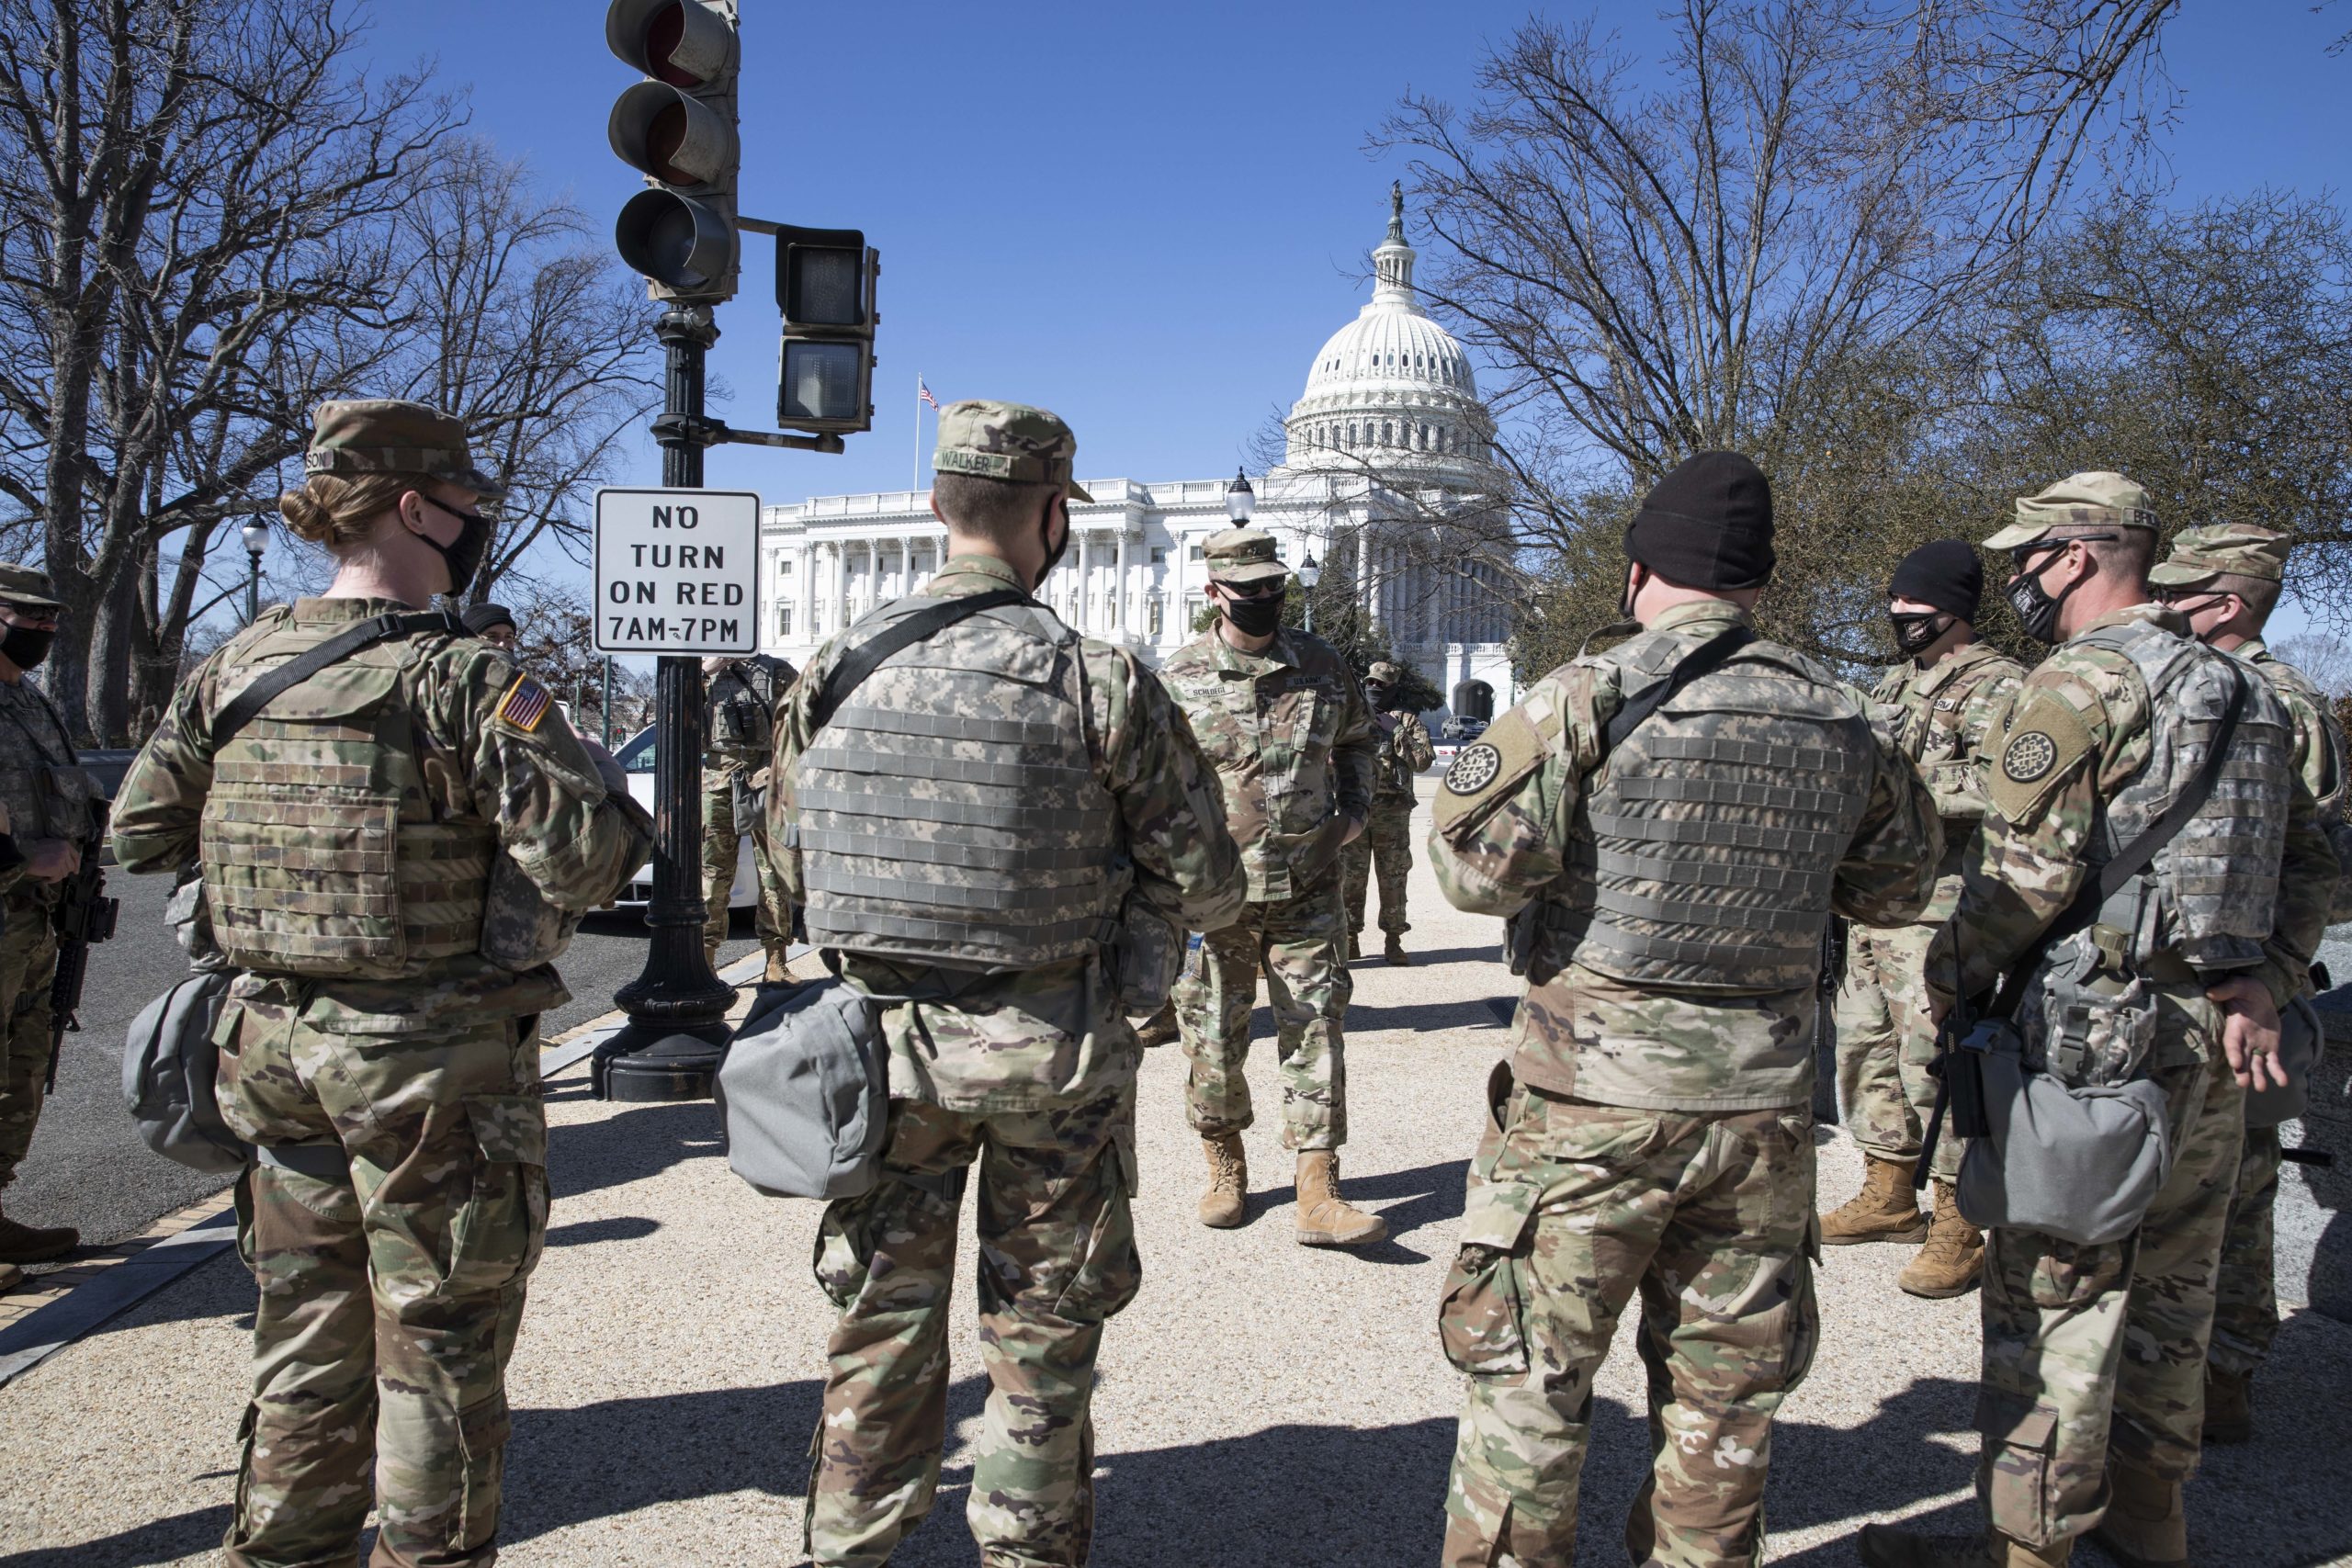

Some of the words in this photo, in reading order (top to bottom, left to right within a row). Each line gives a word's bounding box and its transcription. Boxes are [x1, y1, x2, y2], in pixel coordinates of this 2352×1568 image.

[306, 452, 325, 469] SON
[942, 451, 989, 471] WALKER
[652, 505, 698, 529] NO
[630, 544, 724, 569] TURN
[610, 581, 656, 604] ON
[676, 582, 743, 606] RED
[608, 616, 738, 642] 7AM-7PM
[1305, 675, 1322, 684] ARMY
